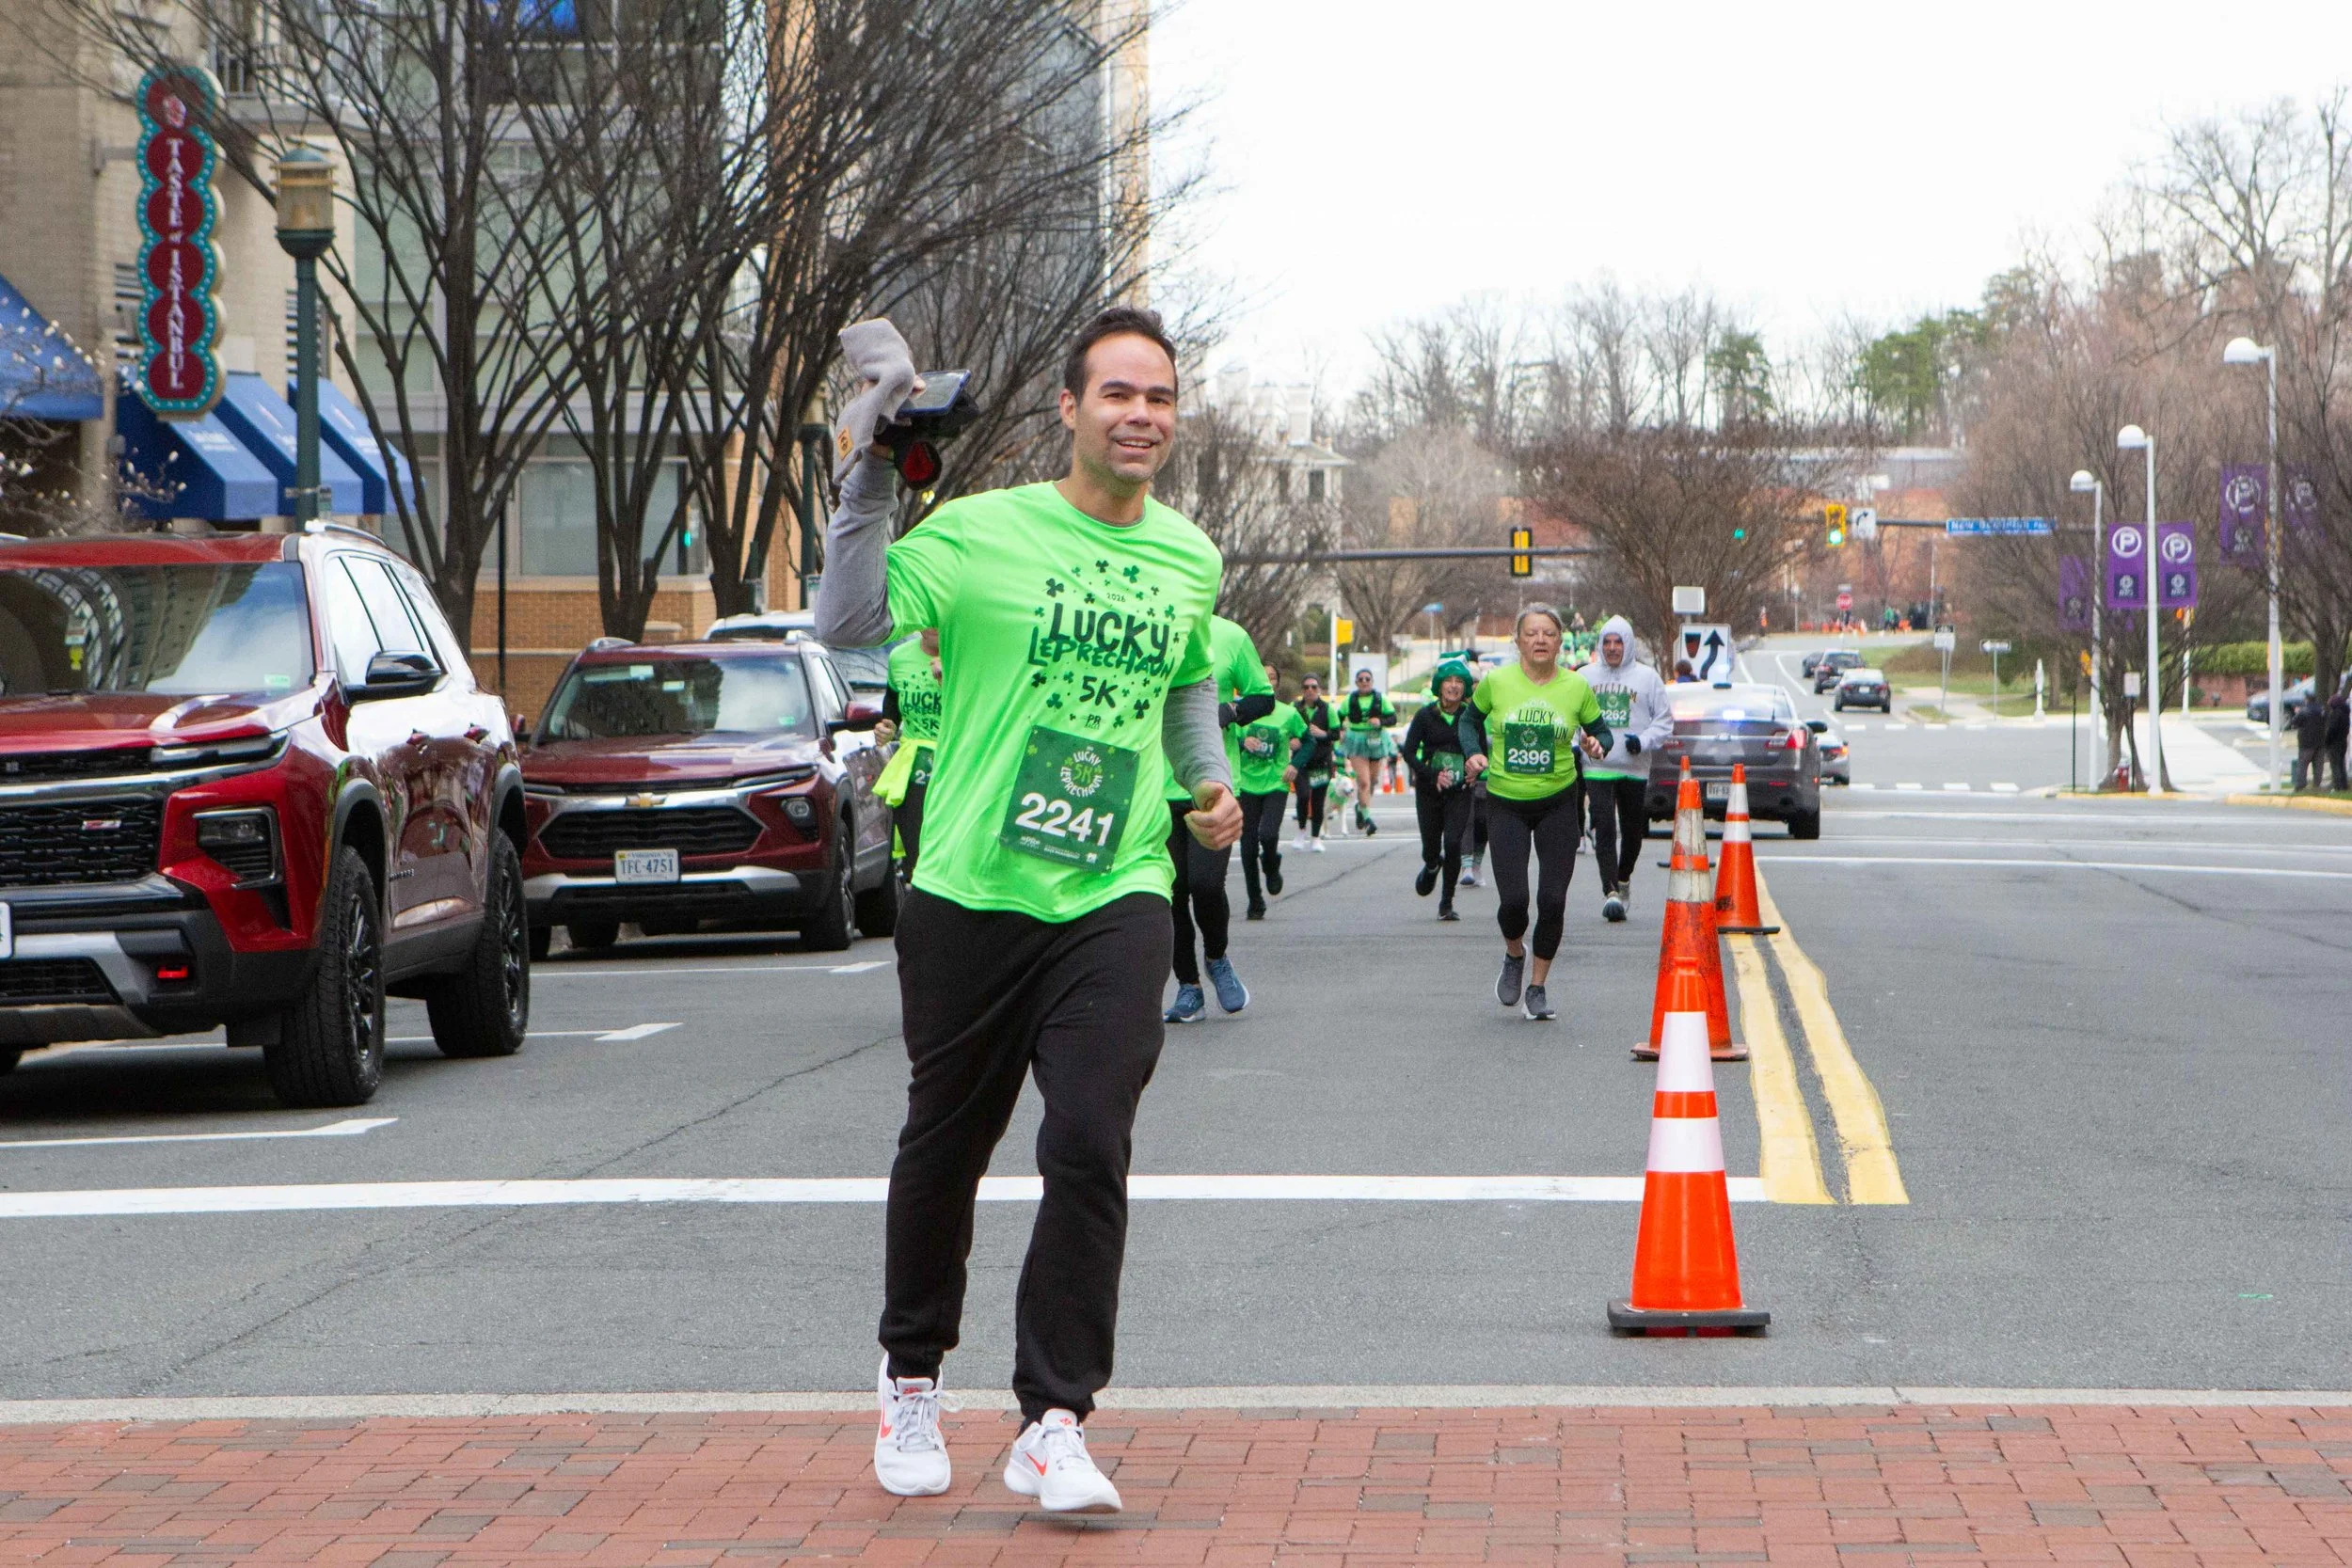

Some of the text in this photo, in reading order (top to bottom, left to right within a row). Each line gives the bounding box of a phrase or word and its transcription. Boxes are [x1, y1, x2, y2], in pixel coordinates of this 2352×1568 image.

[166, 138, 184, 227] TASTE
[167, 249, 185, 389] ISTANBUL
[1106, 593, 1127, 603] 2026
[1049, 602, 1169, 664] LUCKY
[1027, 626, 1175, 681] LEPRECHAUN
[1079, 675, 1119, 708] 5K
[922, 718, 940, 730] 5K
[1518, 709, 1554, 724] LUCKY
[1073, 751, 1102, 767] LUCKY
[1508, 748, 1550, 766] 2396
[1060, 766, 1104, 798] LEPRECHAUN
[1015, 792, 1115, 847] 2241
